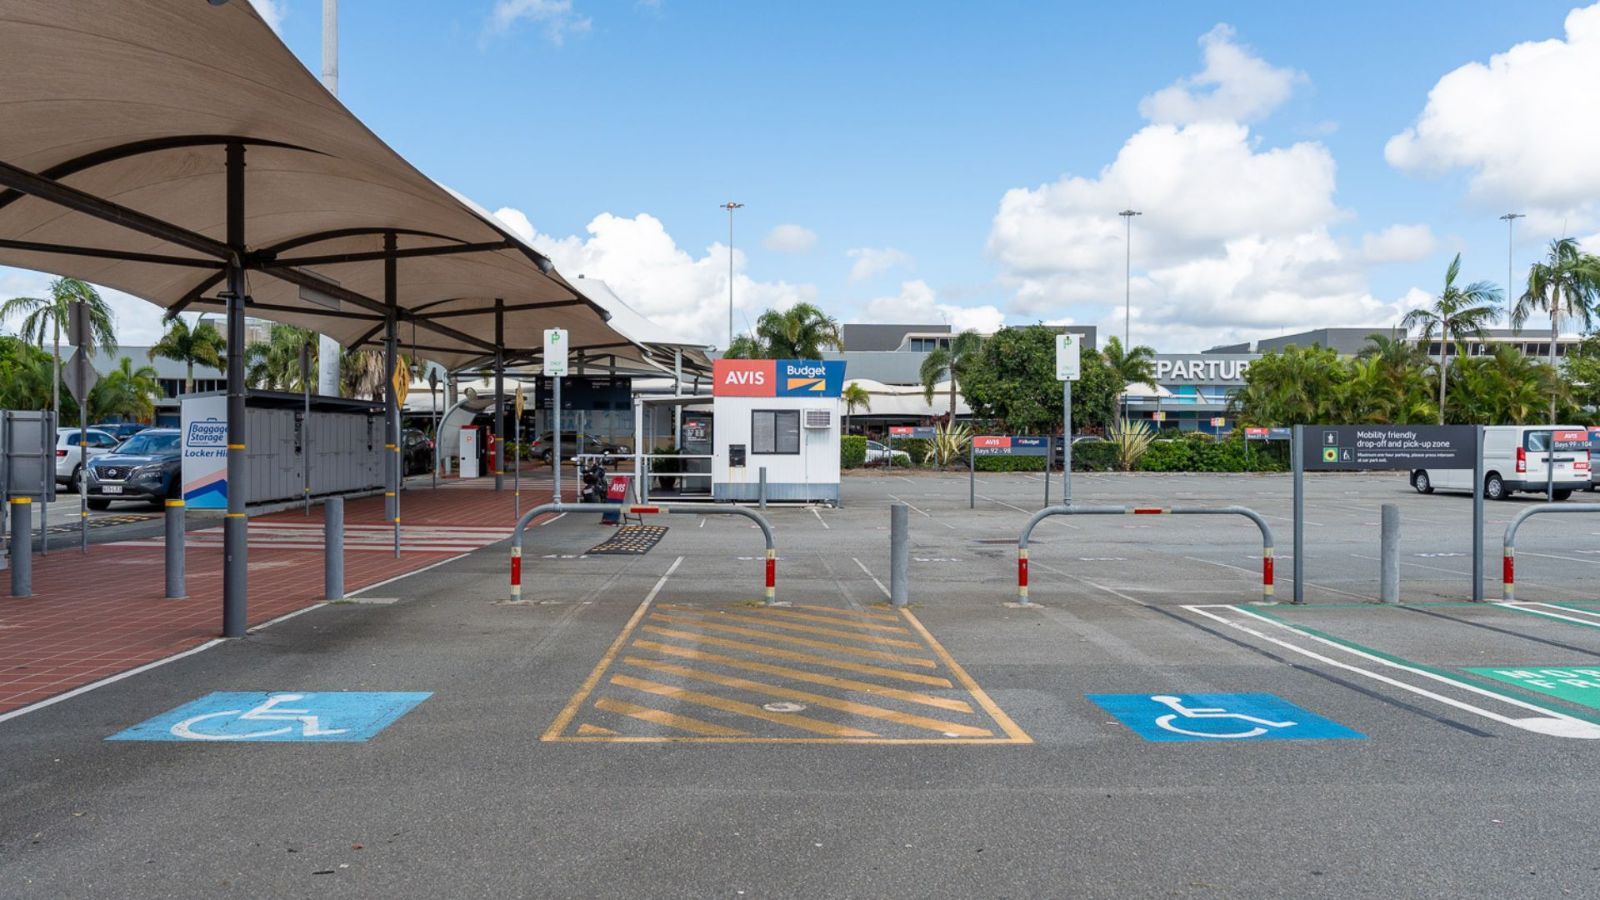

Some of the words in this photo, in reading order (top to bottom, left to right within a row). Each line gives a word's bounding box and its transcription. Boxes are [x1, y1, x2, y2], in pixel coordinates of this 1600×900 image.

[787, 365, 826, 378] Budget
[724, 371, 765, 385] AVIS
[191, 433, 224, 443] Storage
[1356, 431, 1386, 440] Mobility
[1388, 431, 1416, 440] friendly
[1356, 440, 1387, 448] drop-off
[1403, 440, 1432, 448] pick-up
[185, 449, 214, 458] Locker
[610, 483, 626, 492] AVIS
